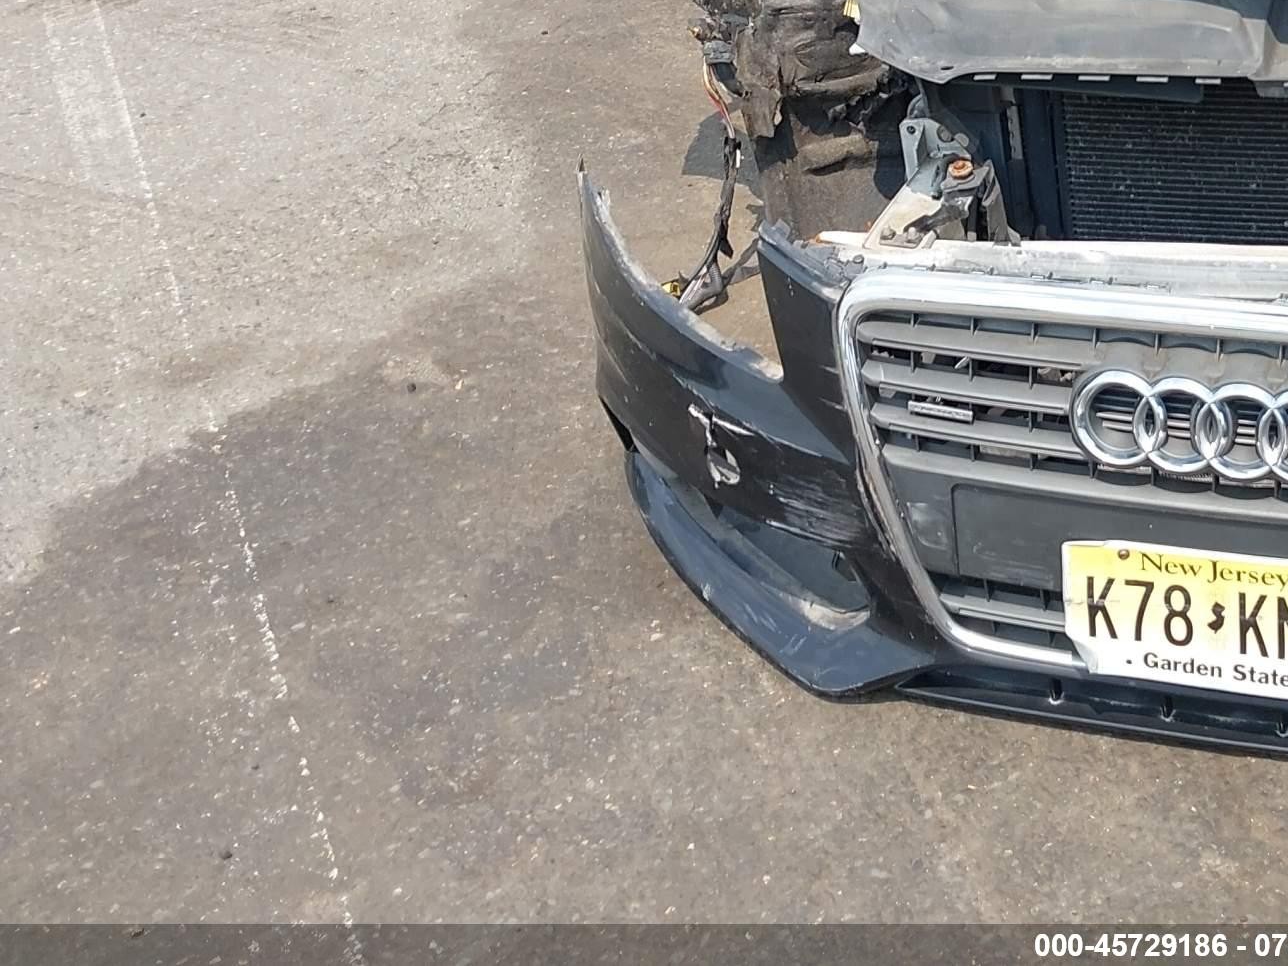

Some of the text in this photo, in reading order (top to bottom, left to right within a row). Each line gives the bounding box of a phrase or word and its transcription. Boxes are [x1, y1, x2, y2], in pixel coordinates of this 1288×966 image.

[1140, 552, 1202, 578] New
[1086, 576, 1194, 646] K78
[1142, 652, 1223, 679] Garden
